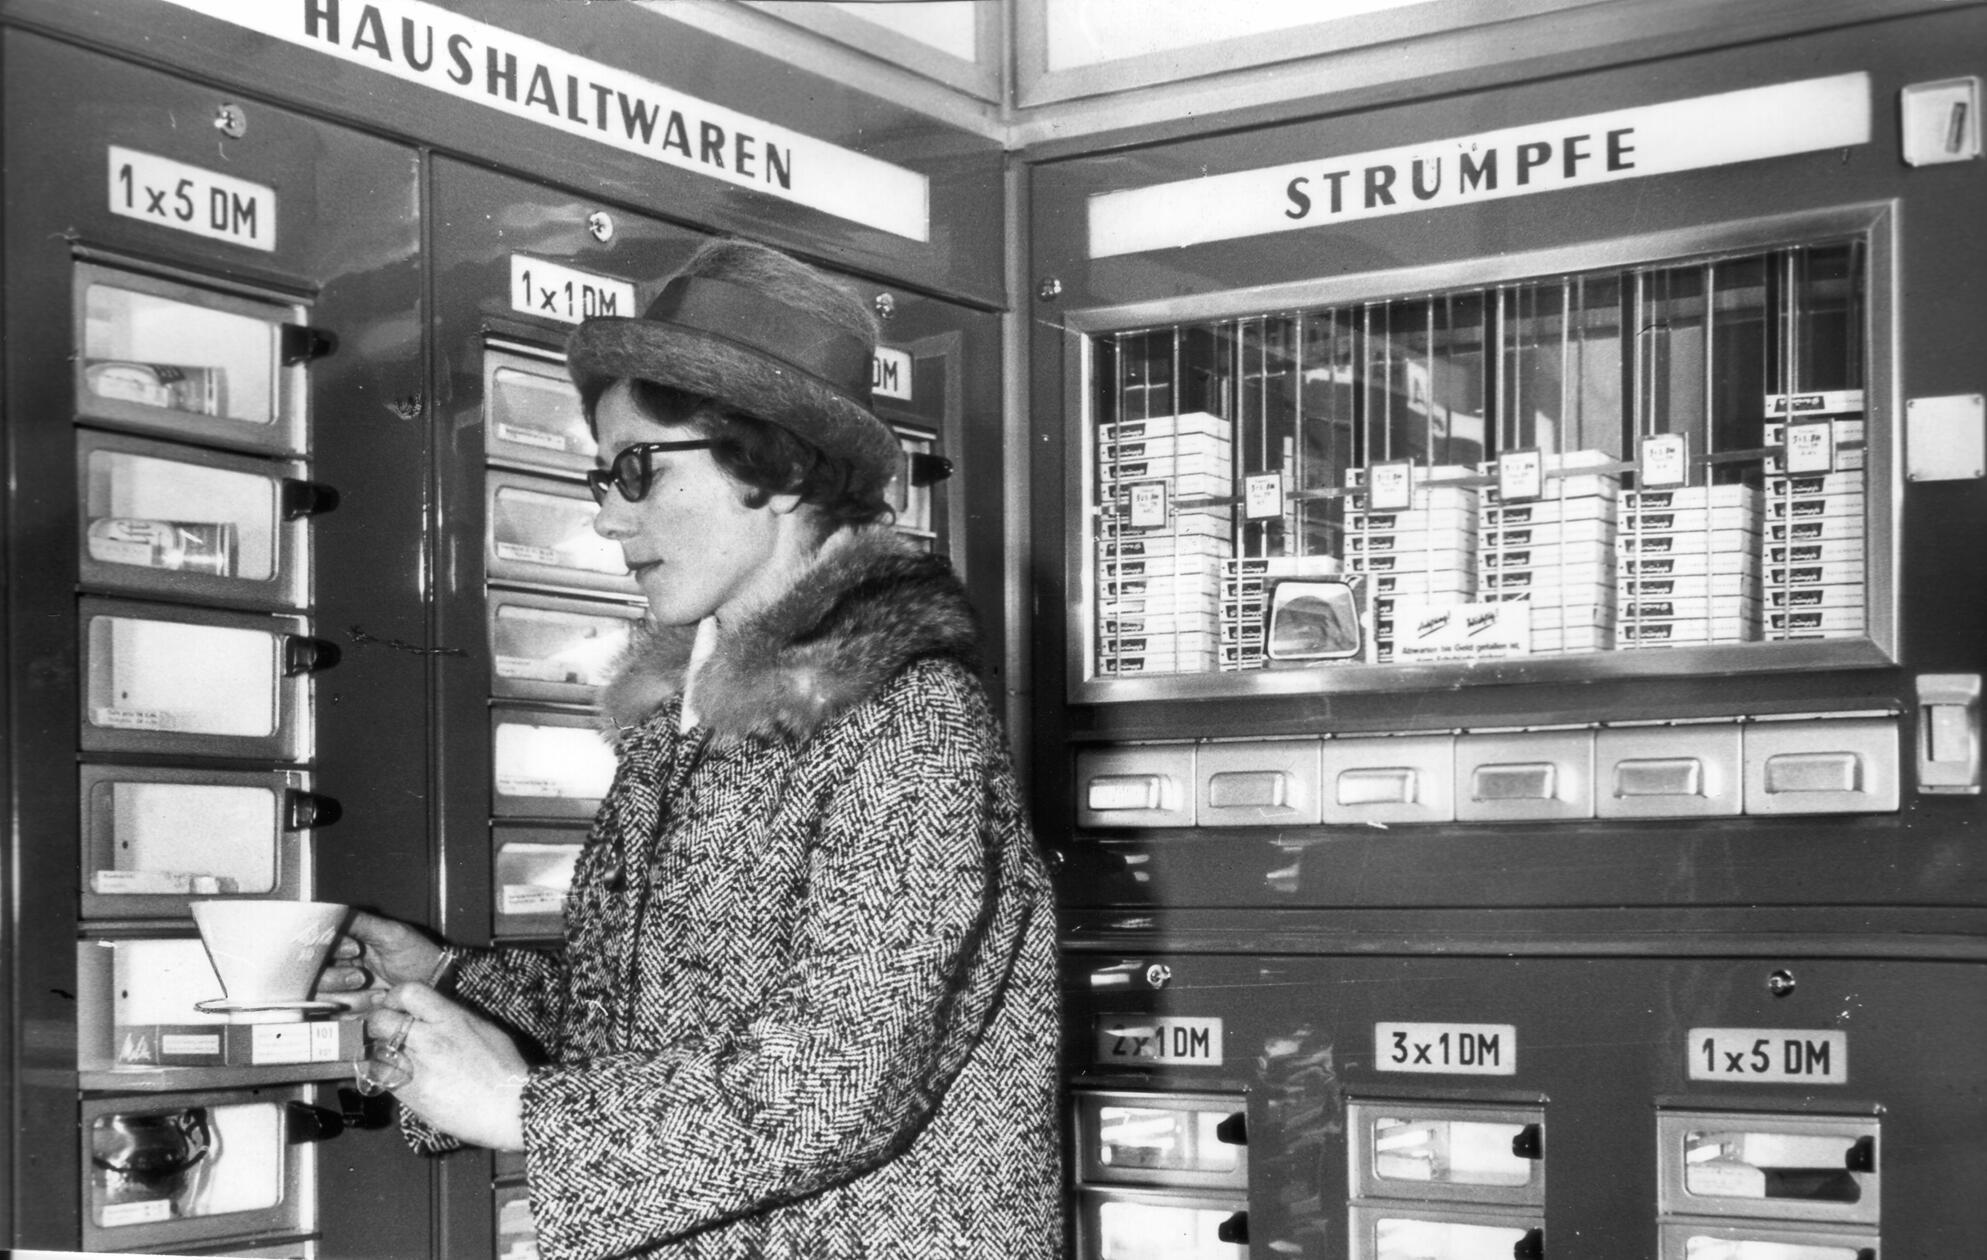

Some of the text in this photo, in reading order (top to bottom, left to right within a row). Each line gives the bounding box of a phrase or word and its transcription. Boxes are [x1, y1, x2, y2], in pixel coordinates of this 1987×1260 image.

[304, 0, 791, 190] HAUSHALTWAREN
[210, 186, 256, 239] DM
[582, 284, 617, 317] DM
[1173, 1026, 1209, 1058] DM
[1459, 1033, 1500, 1067] DM
[1784, 1039, 1830, 1075] DM
